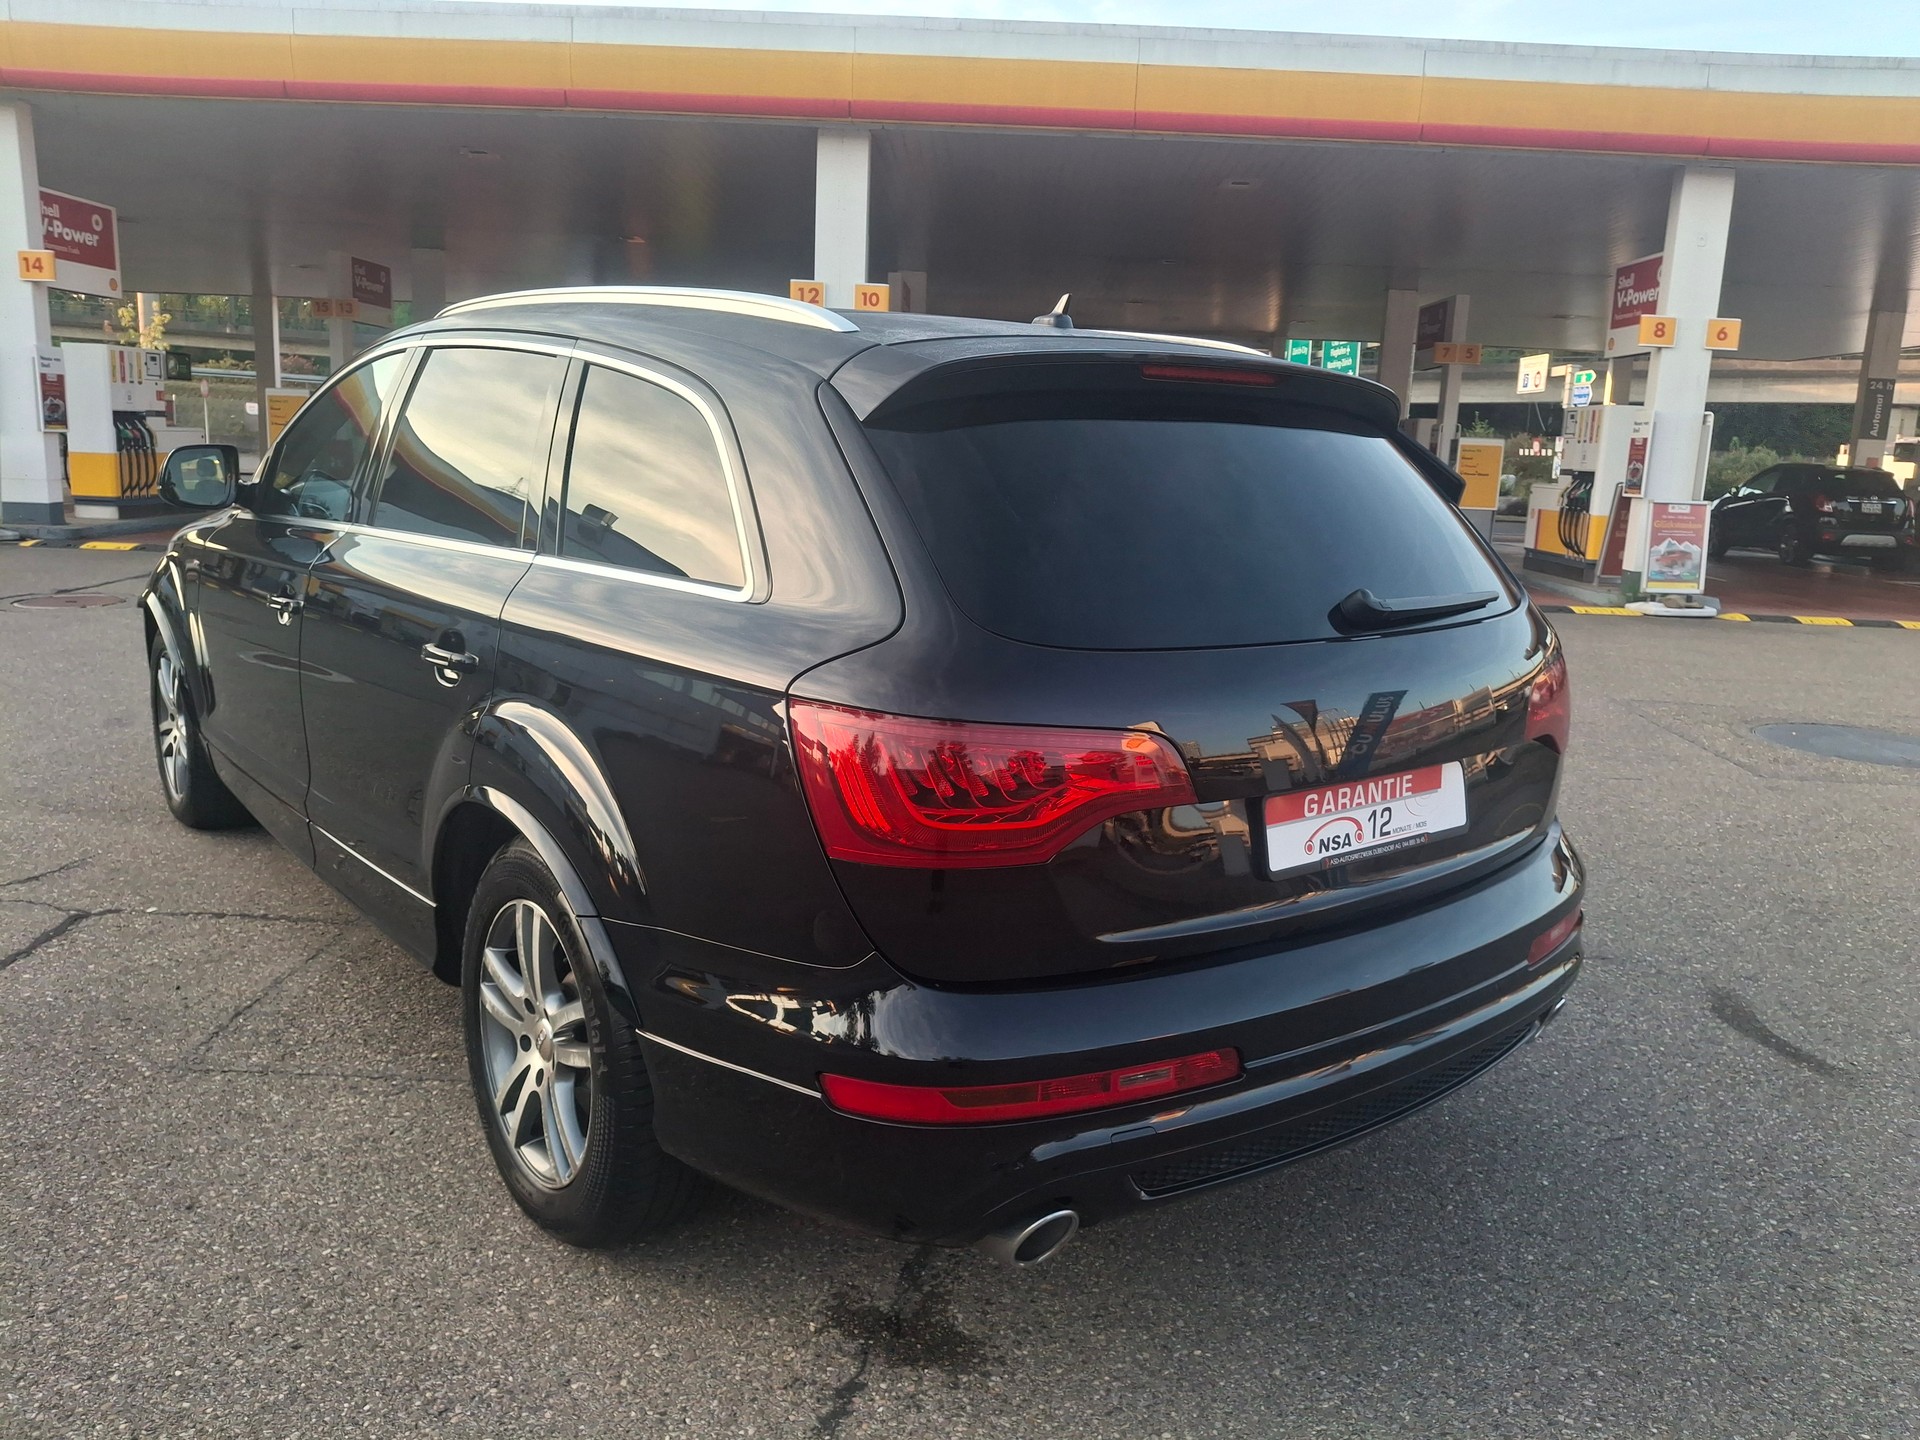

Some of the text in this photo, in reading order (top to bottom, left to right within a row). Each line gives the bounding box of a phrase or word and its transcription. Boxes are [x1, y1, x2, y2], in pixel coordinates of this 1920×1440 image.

[41, 200, 60, 218] hell
[22, 256, 44, 273] 14
[1618, 272, 1635, 289] Shell
[797, 287, 820, 304] 12
[861, 292, 880, 307] 10
[1617, 287, 1660, 308] V-Power
[315, 302, 329, 313] 15
[339, 303, 353, 314] 13
[1654, 322, 1666, 338] 8
[1716, 326, 1728, 341] 6
[1442, 347, 1451, 358] 7
[1465, 348, 1473, 359] 5
[1870, 381, 1893, 390] 24 h
[1869, 394, 1884, 437] Automat
[1304, 775, 1412, 817] GARANTIE
[1368, 806, 1392, 839] 12
[1392, 823, 1411, 834] MONATE
[1415, 820, 1427, 829] MOIS
[1319, 833, 1352, 854] NSA
